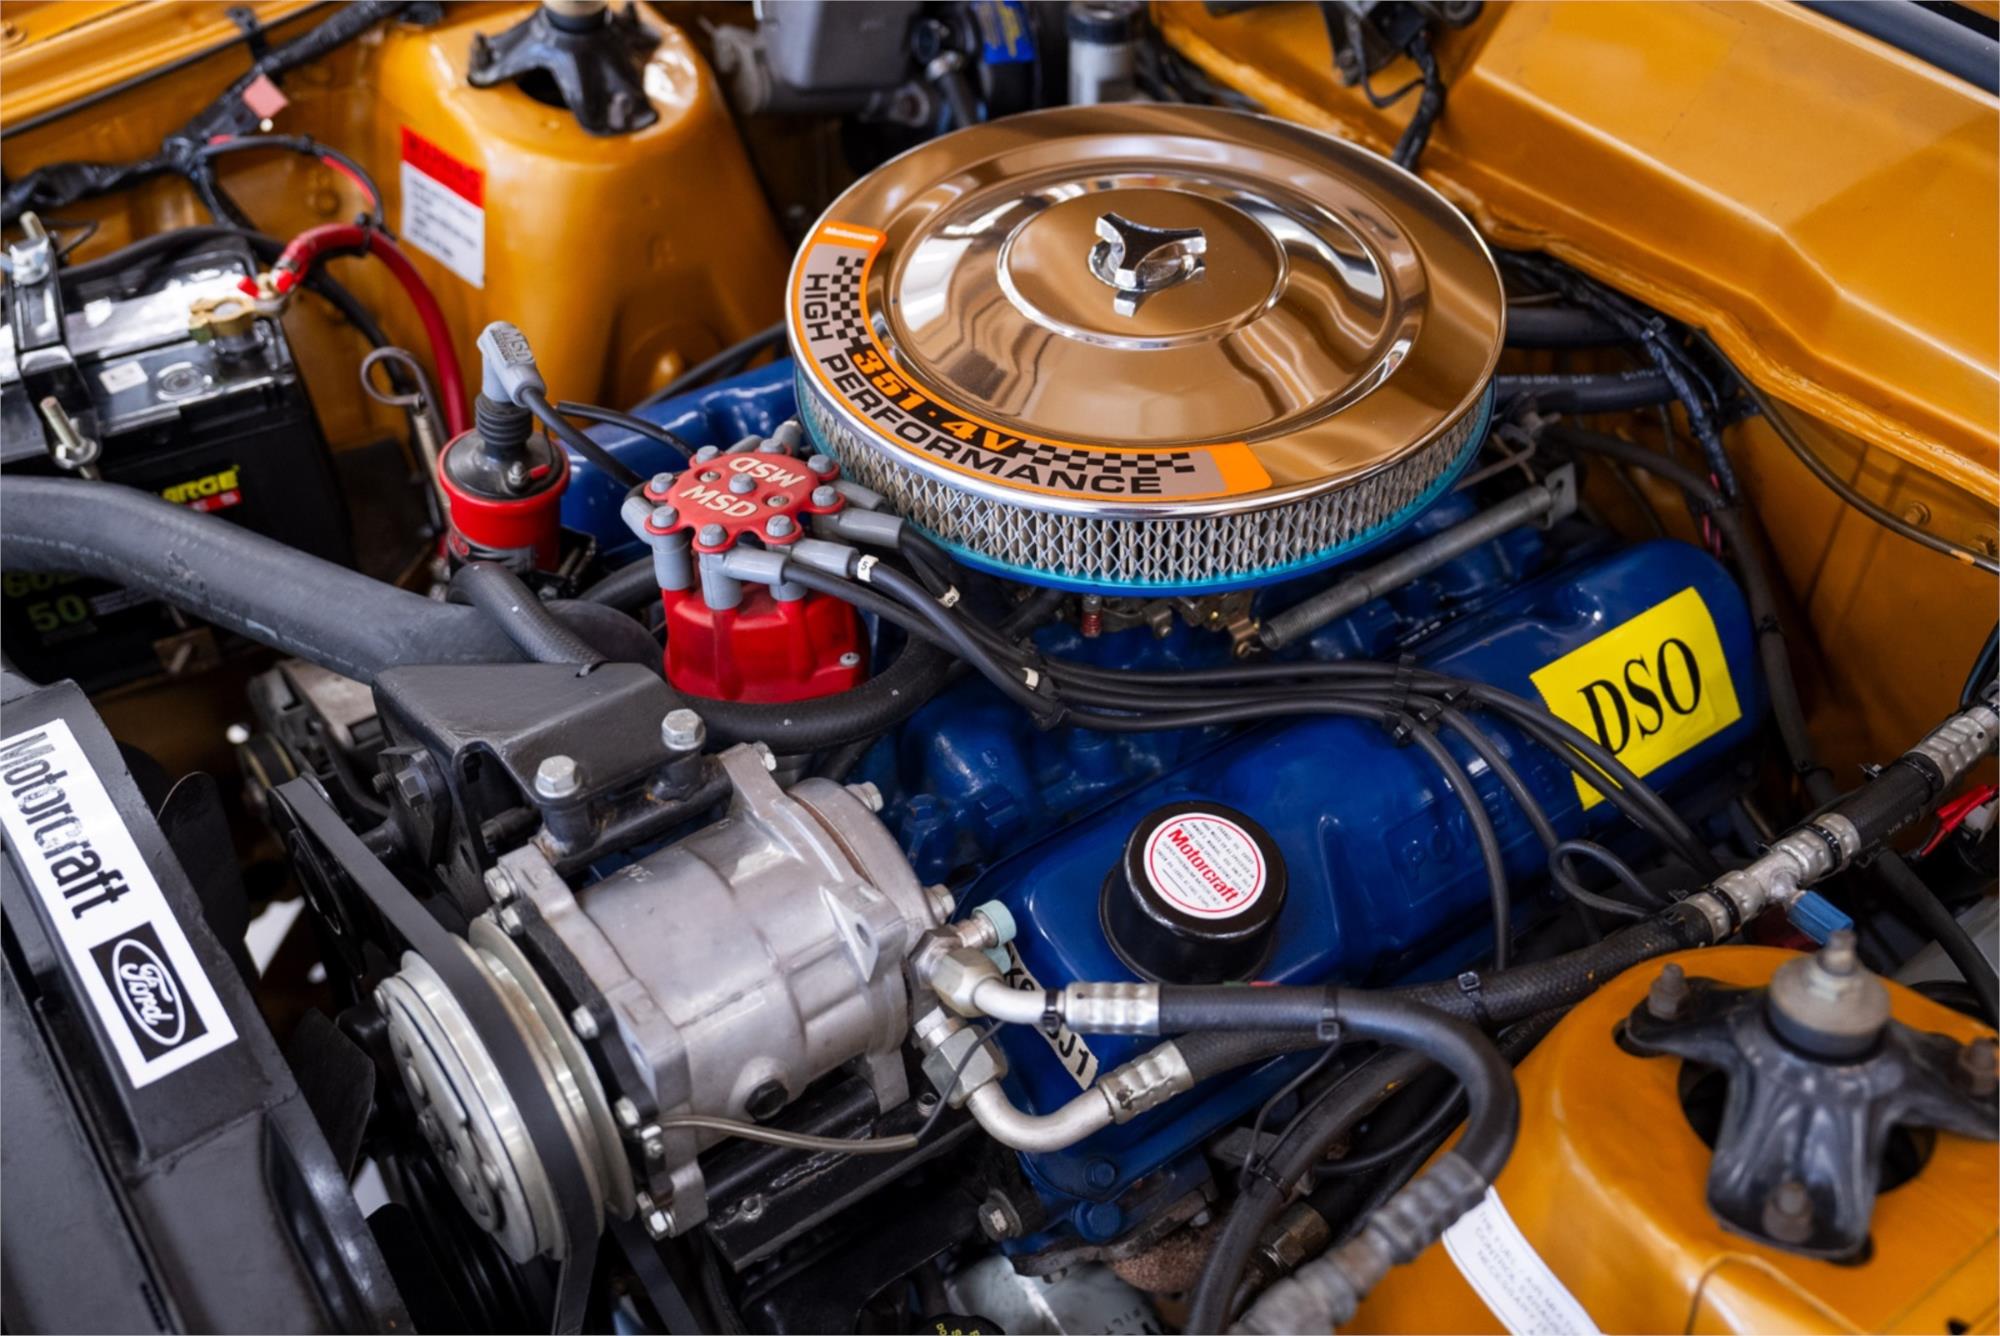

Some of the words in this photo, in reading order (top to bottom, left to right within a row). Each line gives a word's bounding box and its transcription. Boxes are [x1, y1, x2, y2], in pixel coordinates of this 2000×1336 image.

[803, 273, 834, 342] HIGH
[820, 353, 1163, 494] PERFORMANCE
[160, 467, 239, 504] ARGE
[679, 484, 757, 518] MSD
[728, 457, 807, 488] MSD
[26, 593, 88, 632] 50
[1577, 637, 1701, 756] DSO
[0, 731, 131, 920] Motorcraft
[1167, 828, 1240, 903] Motorcraft
[119, 962, 174, 1026] Ford
